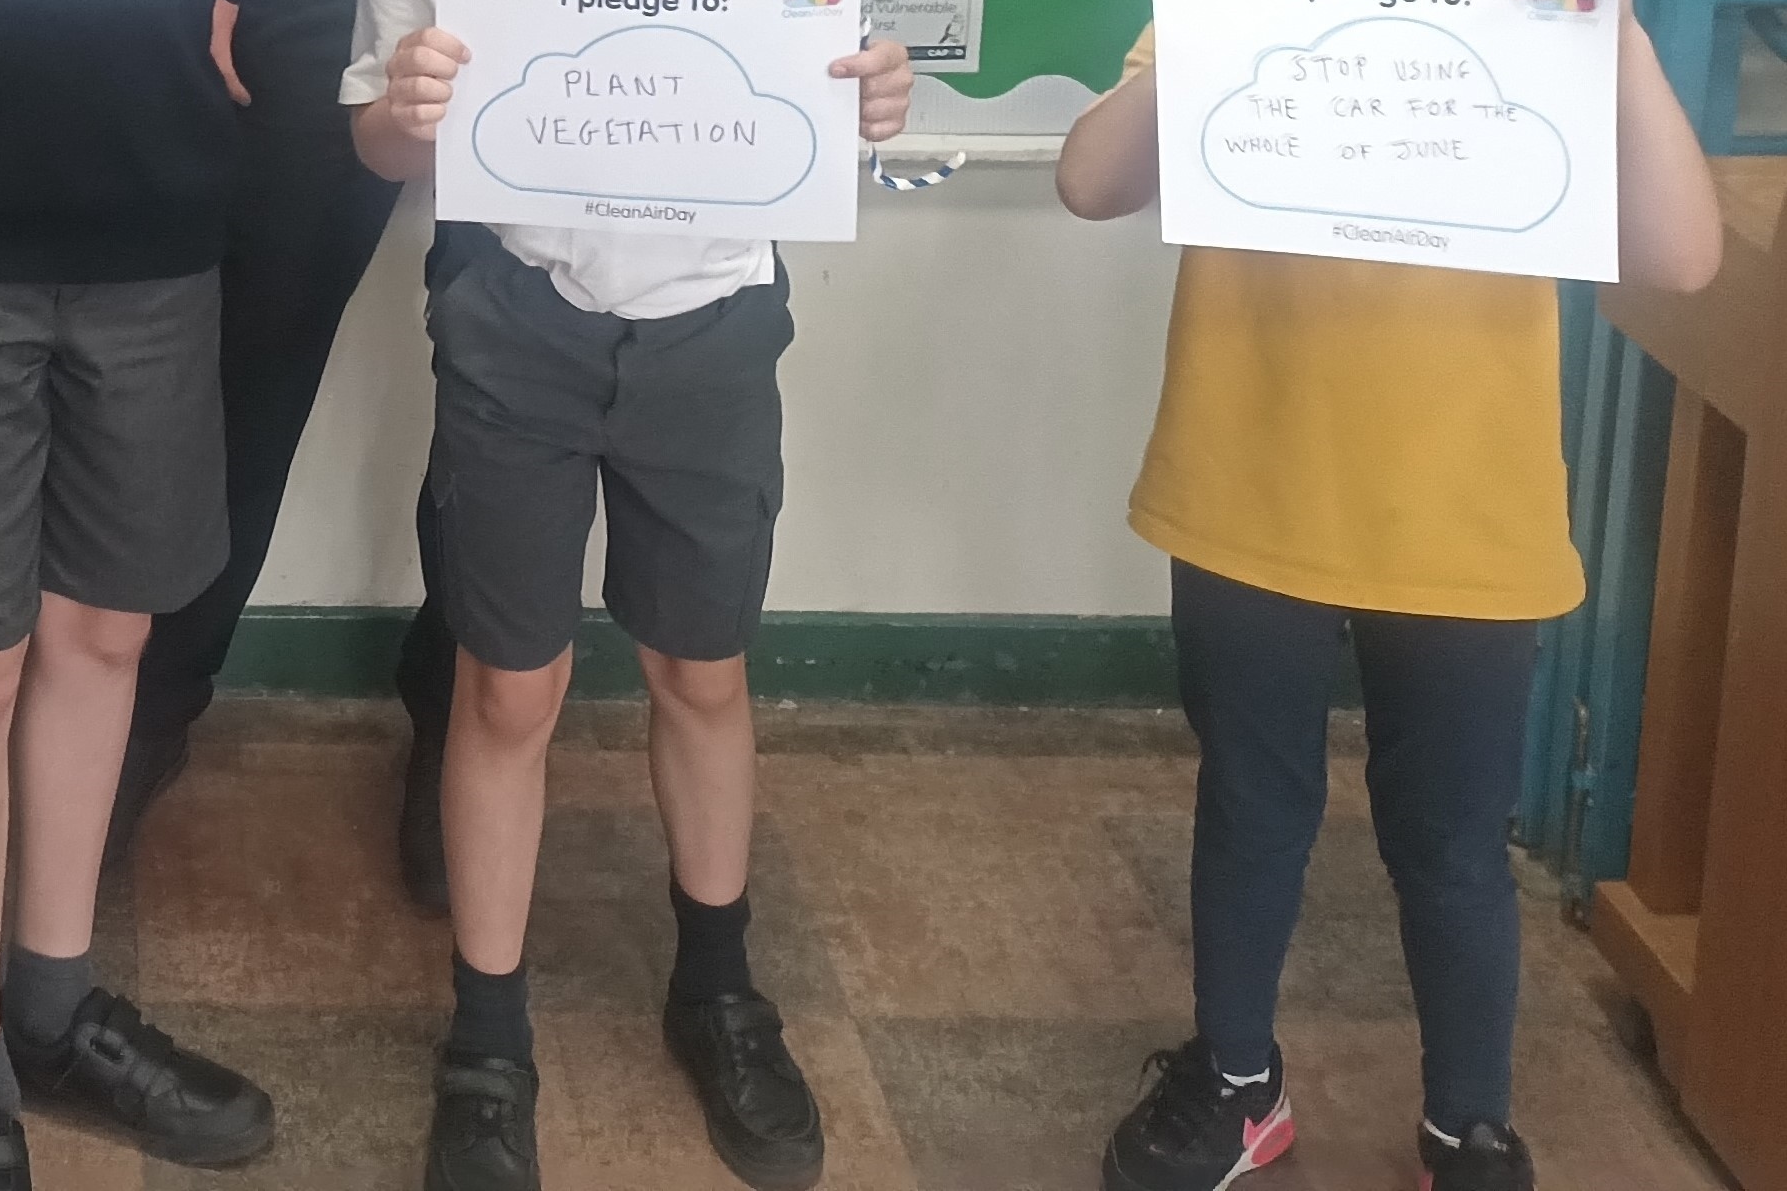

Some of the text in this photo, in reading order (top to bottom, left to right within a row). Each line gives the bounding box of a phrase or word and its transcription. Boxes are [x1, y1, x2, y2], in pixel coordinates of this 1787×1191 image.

[875, 0, 957, 13] vulnerable
[1291, 53, 1473, 83] STOP USING
[563, 69, 684, 98] PLANT
[1247, 94, 1519, 123] THE CAR FOR THE
[526, 115, 758, 147] VEGETATION
[1224, 135, 1471, 163] WHOLE OF JUNE
[584, 201, 697, 224] #CleanAirDay
[1332, 223, 1451, 250] #CleanAirDay
